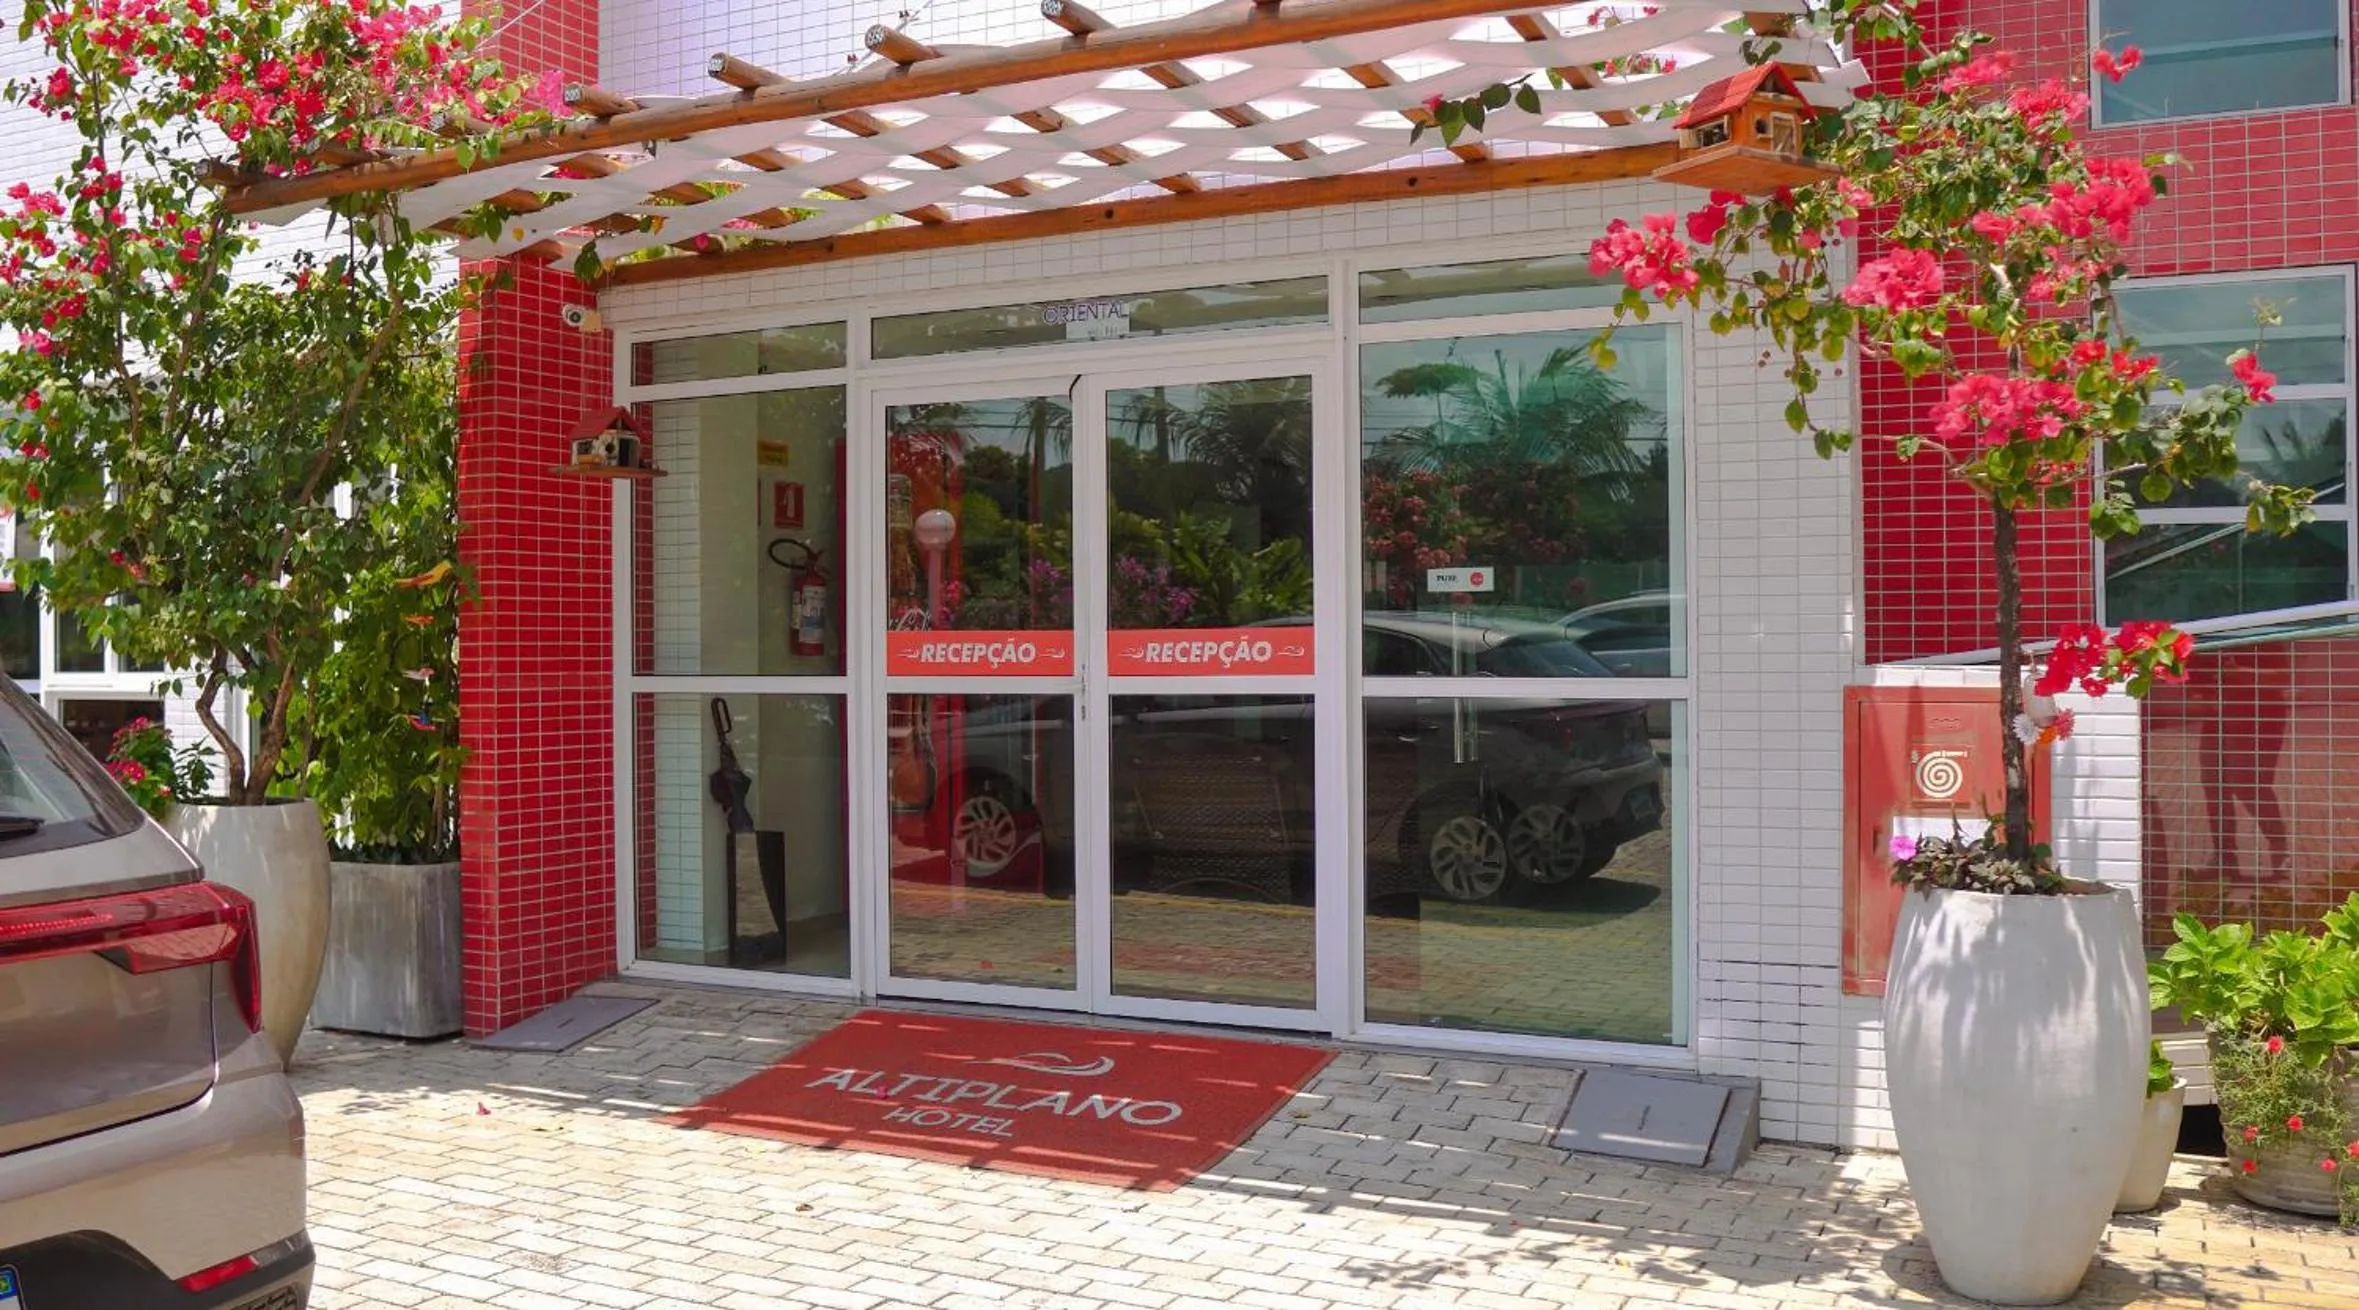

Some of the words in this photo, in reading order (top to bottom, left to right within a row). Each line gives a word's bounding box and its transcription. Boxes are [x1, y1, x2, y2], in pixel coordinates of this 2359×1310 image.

[1043, 302, 1129, 324] ORIENTAL
[920, 637, 1036, 668] RECEPÇÃO
[1145, 635, 1272, 668] RECEPÇÃO
[804, 1069, 1183, 1126] ALTIPLANO
[882, 1106, 1016, 1137] HOTEL
